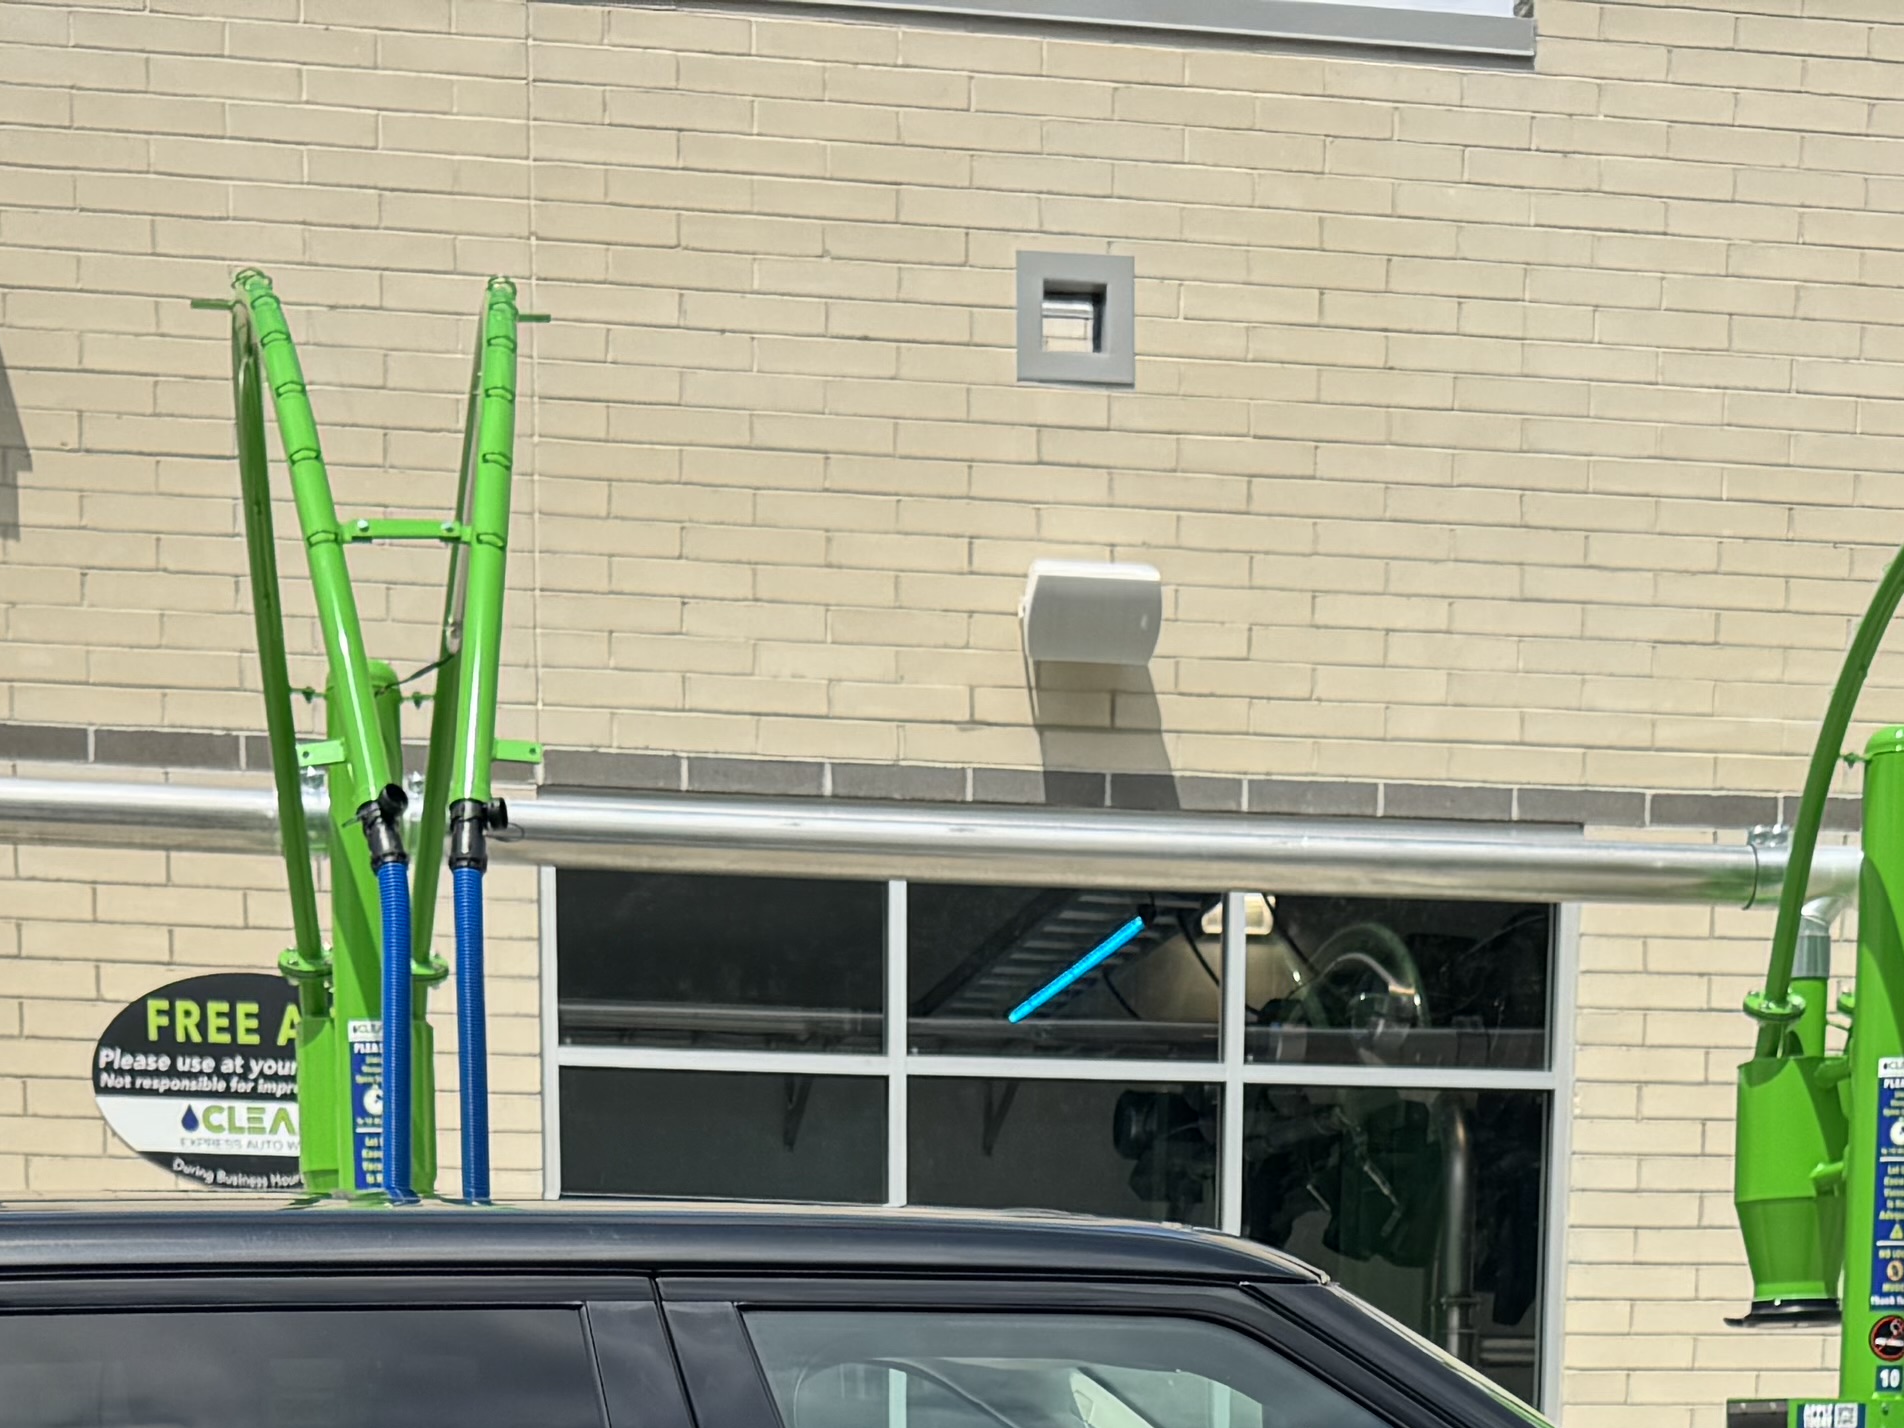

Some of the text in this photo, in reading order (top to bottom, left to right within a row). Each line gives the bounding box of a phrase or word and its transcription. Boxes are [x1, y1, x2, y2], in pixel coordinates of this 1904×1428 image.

[147, 998, 302, 1047] FREE A
[99, 1047, 171, 1071] Please
[176, 1055, 216, 1074] use
[220, 1054, 245, 1074] at
[100, 1072, 132, 1089] Not
[135, 1074, 227, 1094] responsible
[230, 1075, 255, 1094] for
[202, 1105, 296, 1135] CLEA
[180, 1137, 300, 1151] EXPRESS AUTO W
[172, 1156, 306, 1190] During Business Hour
[1879, 1368, 1901, 1388] 10
